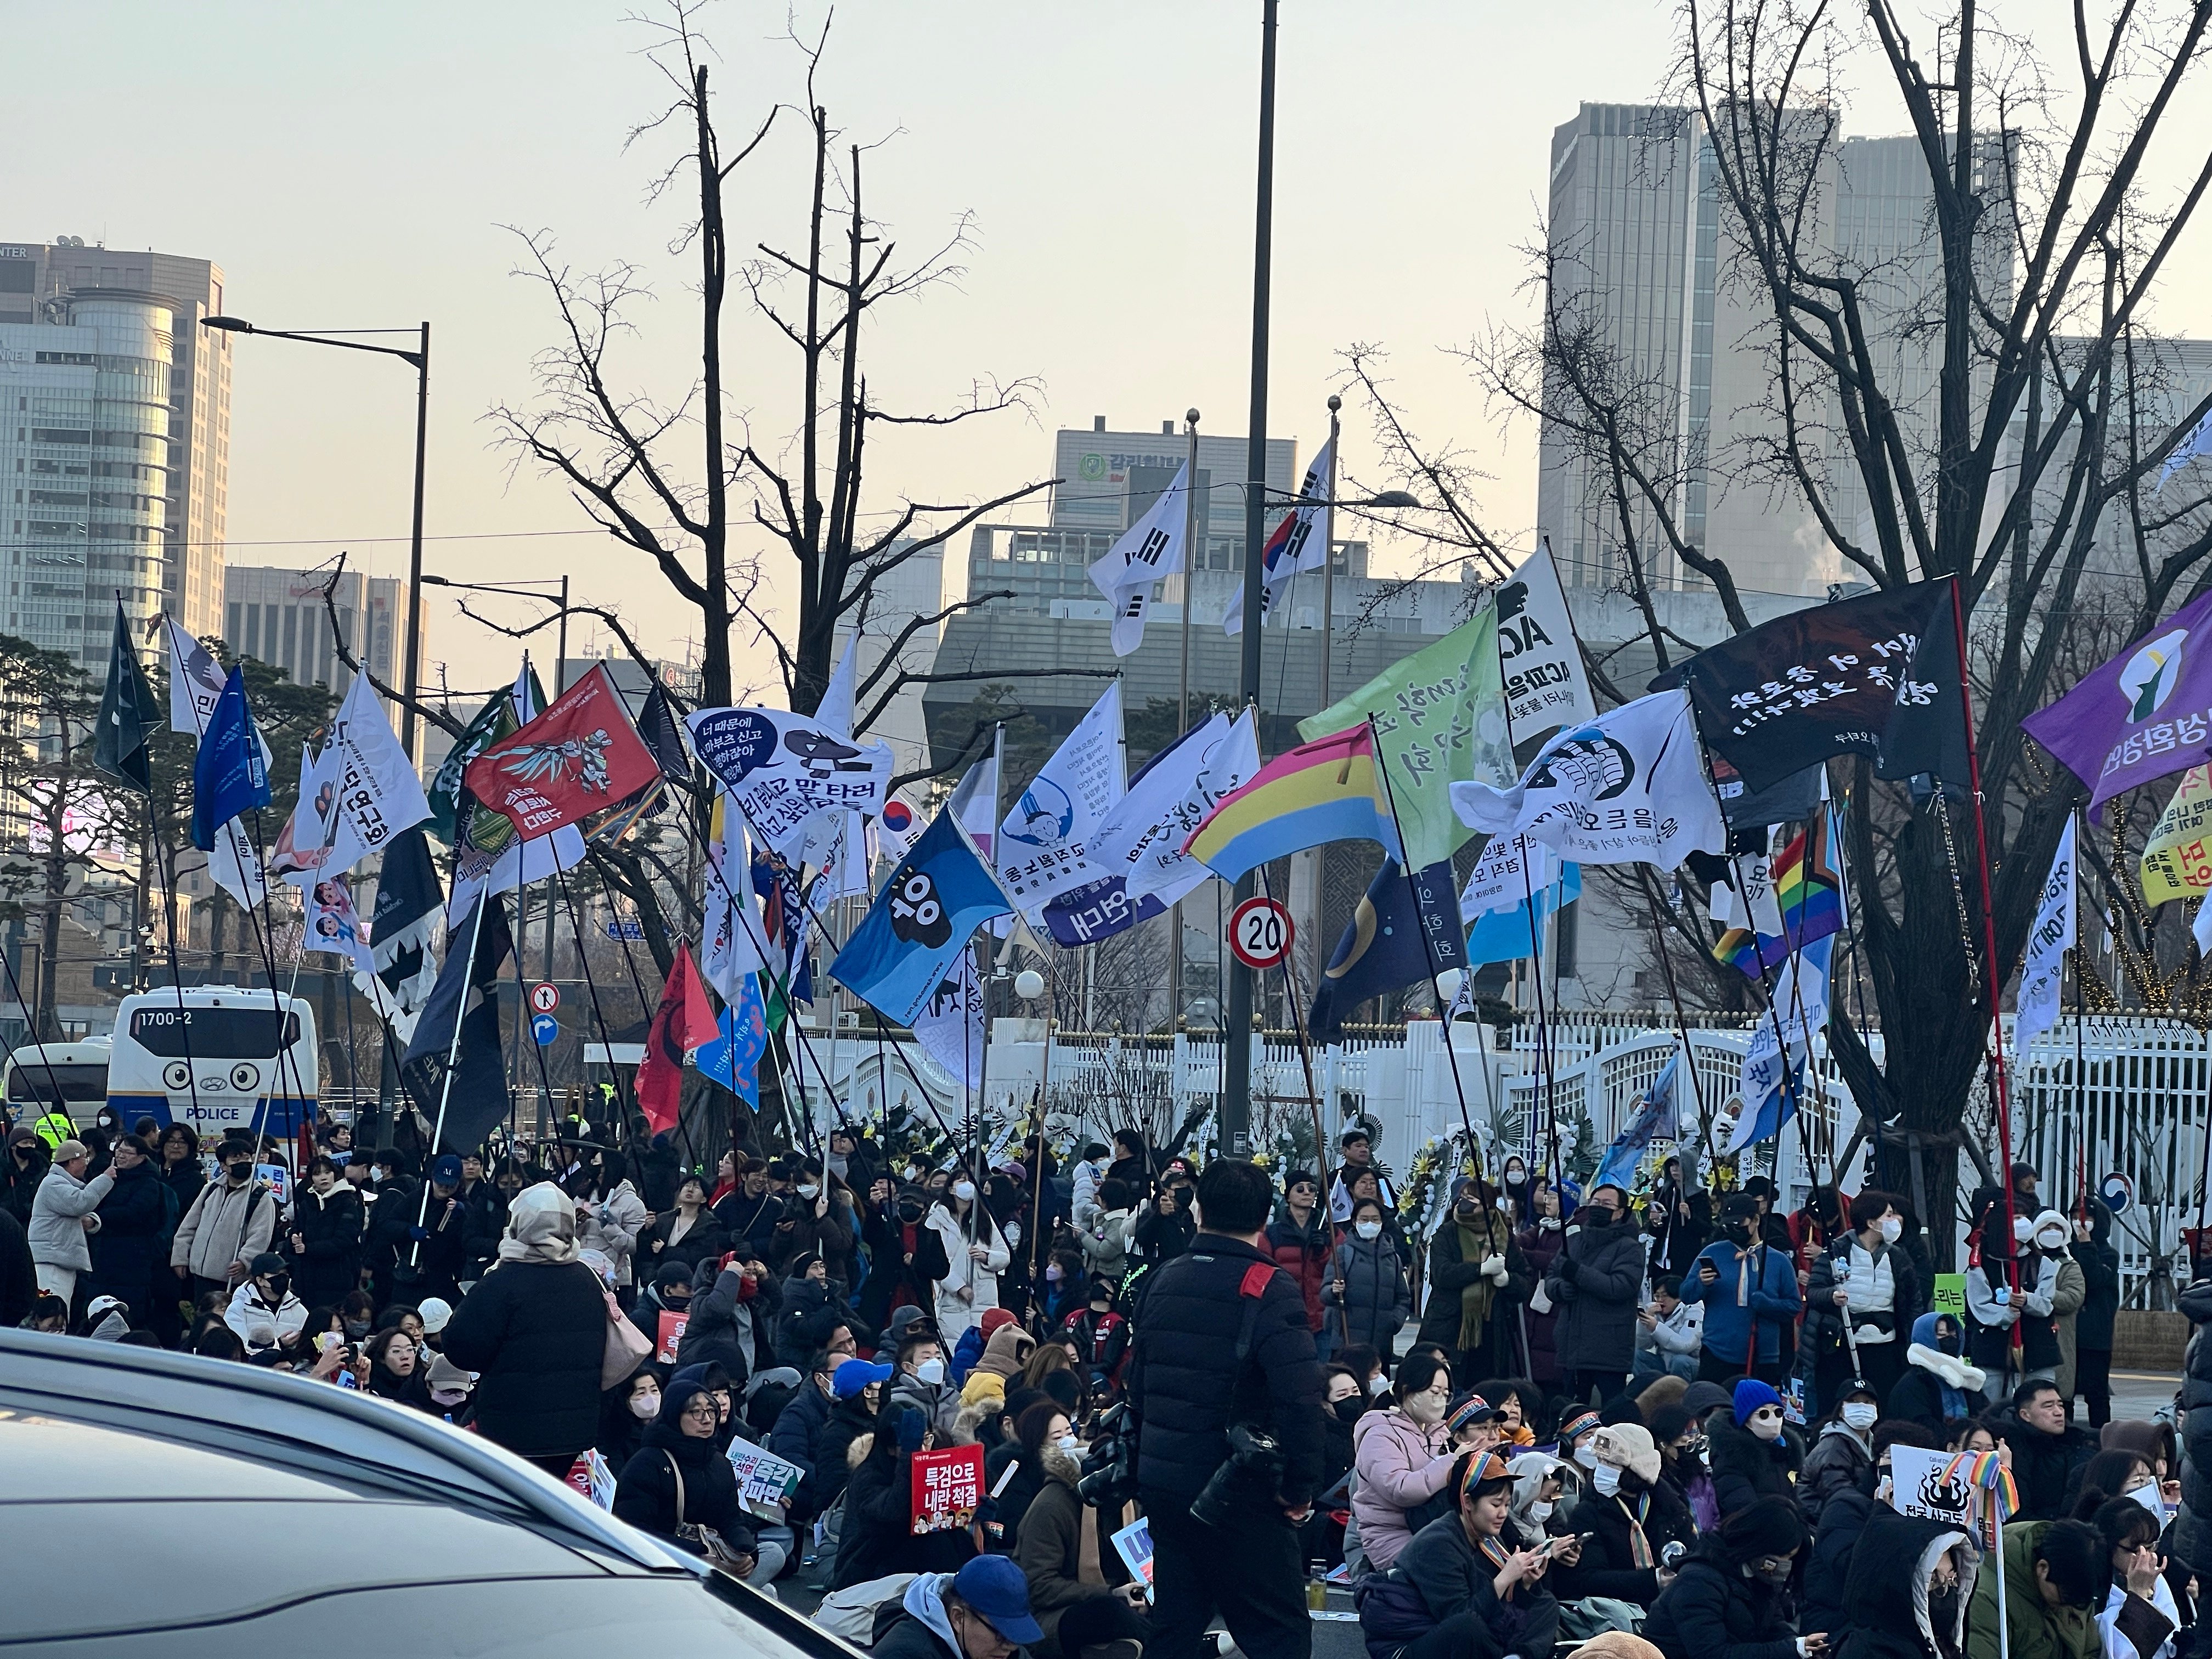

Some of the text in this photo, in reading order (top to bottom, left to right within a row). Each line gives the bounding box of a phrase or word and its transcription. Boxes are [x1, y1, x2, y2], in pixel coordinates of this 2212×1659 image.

[702, 716, 753, 736] 너 때문에
[737, 729, 763, 744] 신고
[743, 793, 763, 818] 리
[826, 782, 876, 798] 타러
[346, 790, 390, 845] 연구회
[1248, 916, 1280, 951] 20
[141, 1012, 192, 1026] 1700-2
[186, 1108, 239, 1120] POLICE
[1934, 1289, 1963, 1306] 리는
[754, 1459, 794, 1487] 즉각
[925, 1462, 976, 1489] 특검으로
[746, 1480, 784, 1507] 파면
[925, 1483, 977, 1512] 내란 척결
